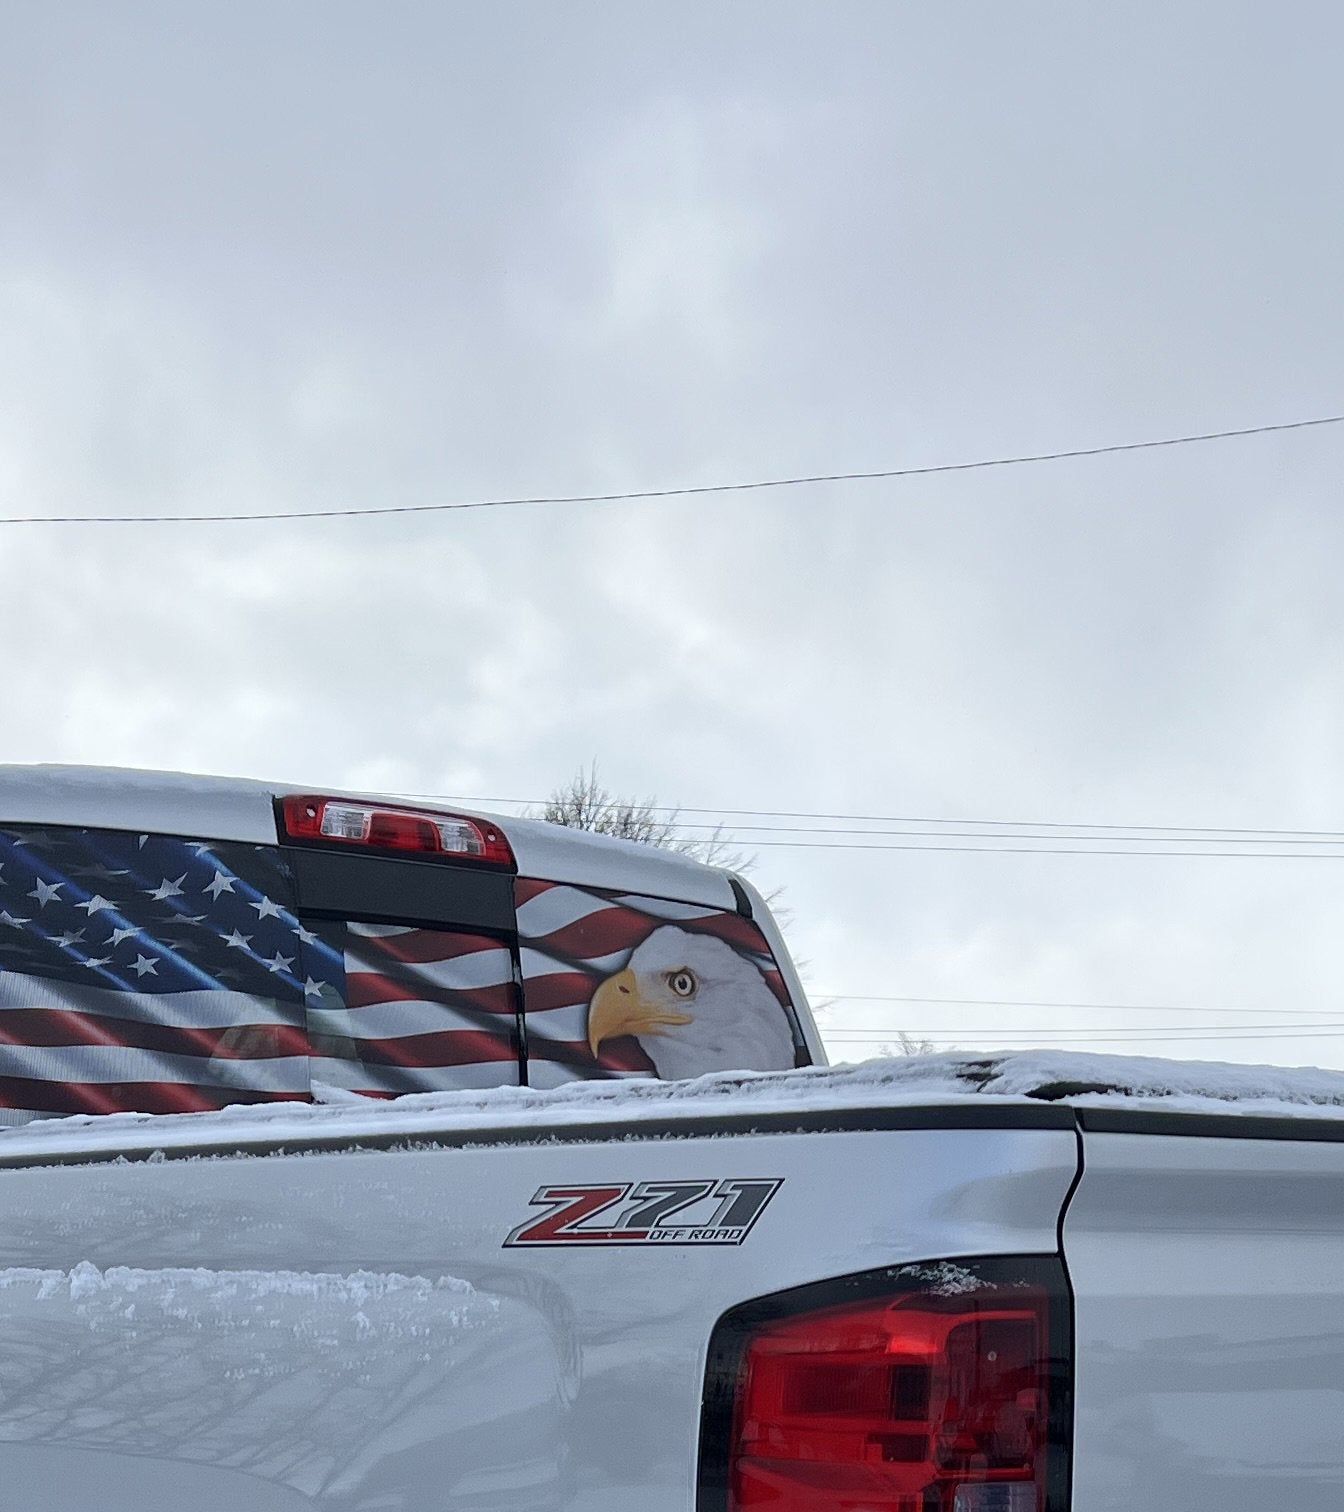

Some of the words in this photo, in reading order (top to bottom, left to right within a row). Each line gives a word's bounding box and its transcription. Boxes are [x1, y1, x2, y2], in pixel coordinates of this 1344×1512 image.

[502, 1178, 785, 1248] Z71
[649, 1229, 686, 1240] OFF
[688, 1229, 744, 1240] ROAD
